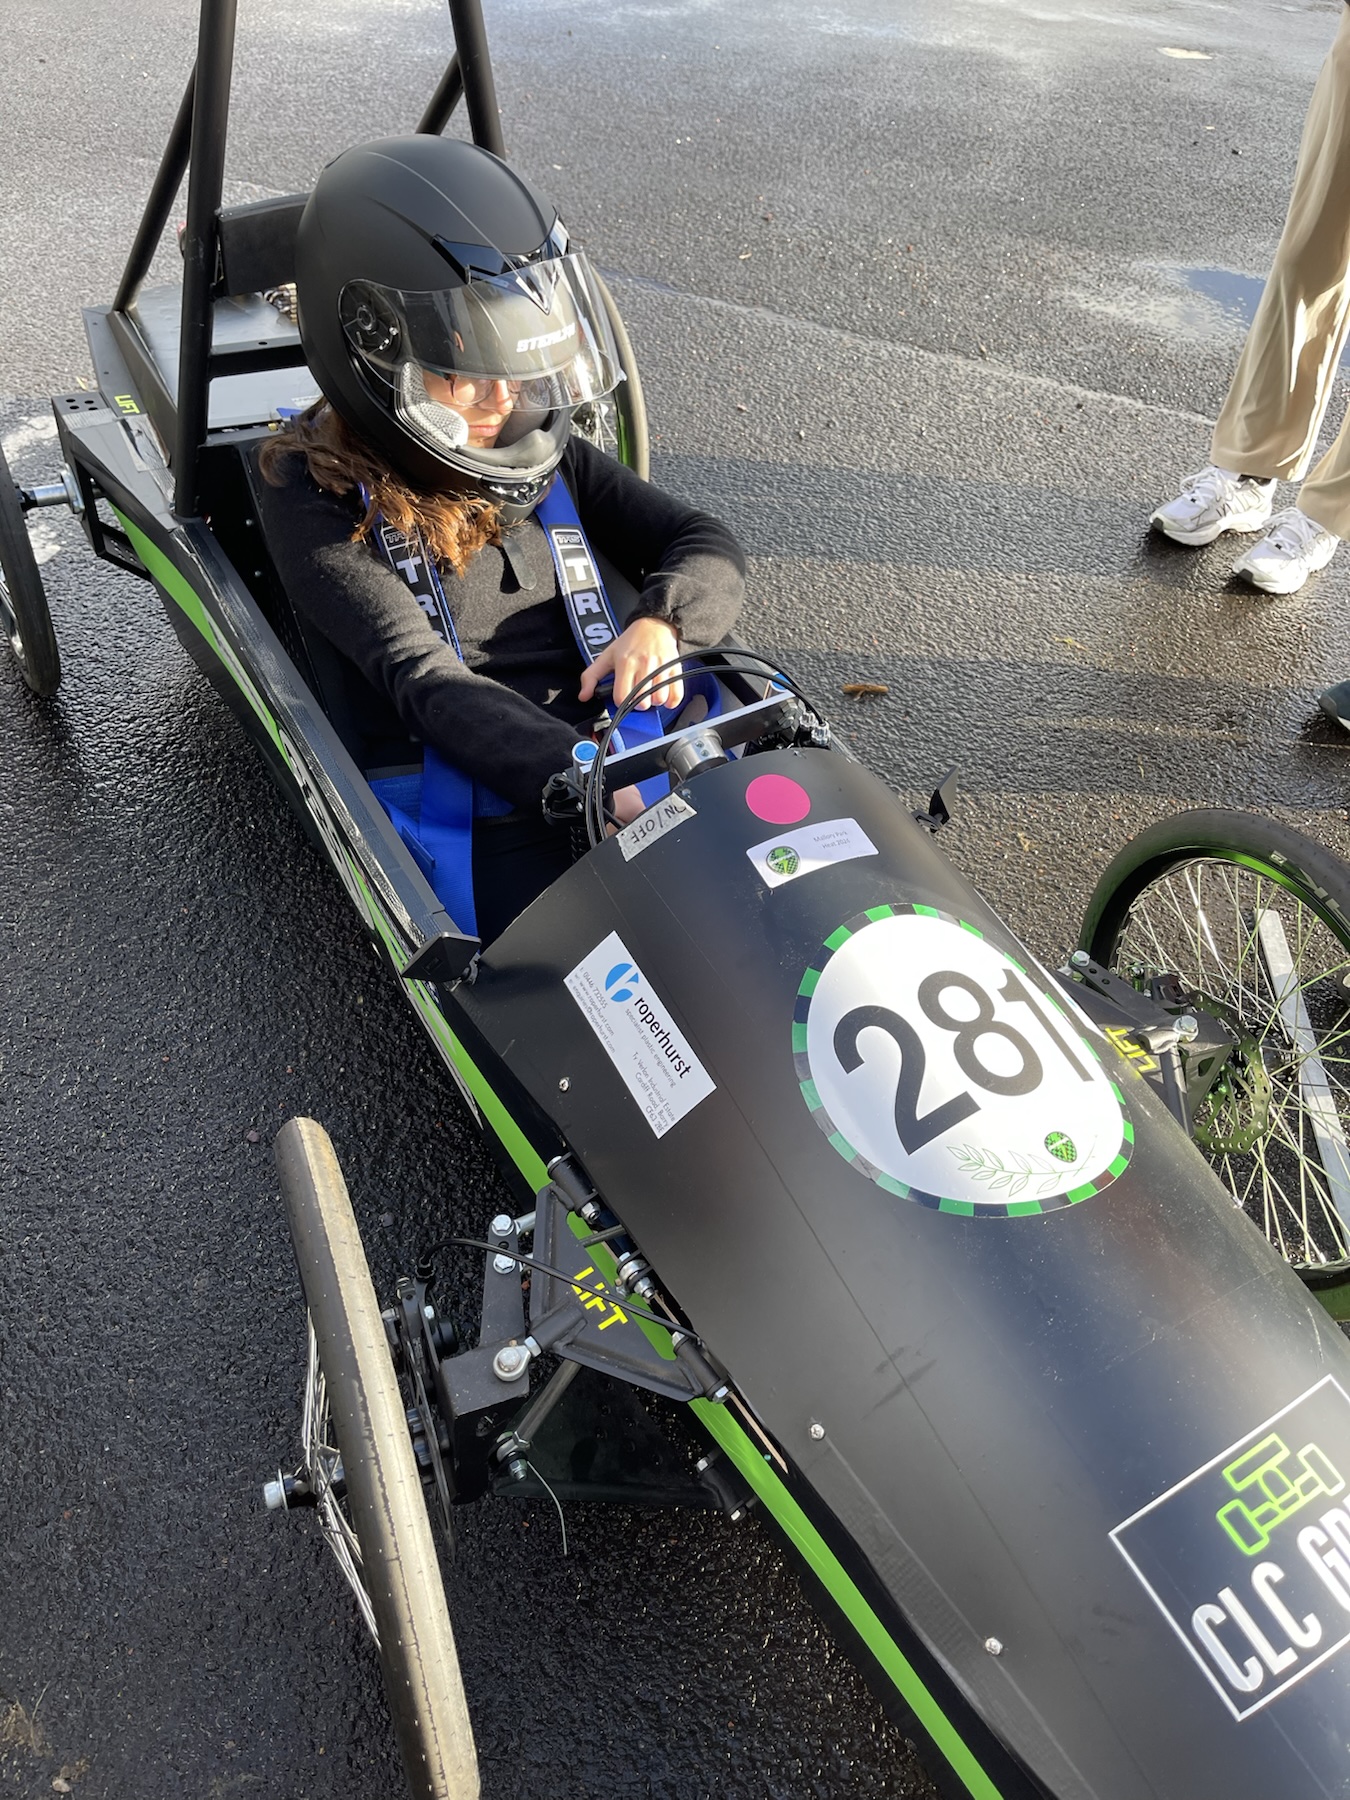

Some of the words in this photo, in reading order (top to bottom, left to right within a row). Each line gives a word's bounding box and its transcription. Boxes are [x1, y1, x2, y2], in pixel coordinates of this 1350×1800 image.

[114, 394, 140, 414] LIFT
[396, 555, 444, 639] TR
[565, 557, 613, 646] TRS
[572, 985, 615, 1053] enquiries@roperhurst.com
[579, 981, 616, 1037] www.roperhurst.com
[634, 997, 691, 1079] roperhurst
[625, 1008, 644, 1035] specialist
[640, 1034, 655, 1054] plastic
[654, 1054, 677, 1088] engineering
[833, 967, 1095, 1156] 281
[1105, 1027, 1157, 1072] LIFT
[632, 1051, 639, 1060] Ty
[637, 1059, 649, 1079] Verlon
[647, 1077, 667, 1104] Industrial
[663, 1102, 676, 1122] Estate
[635, 1071, 650, 1092] Cardiff
[657, 1109, 669, 1127] Barry
[645, 1105, 658, 1122] CF63
[571, 1266, 629, 1331] LIFT
[1191, 1560, 1322, 1692] CLC
